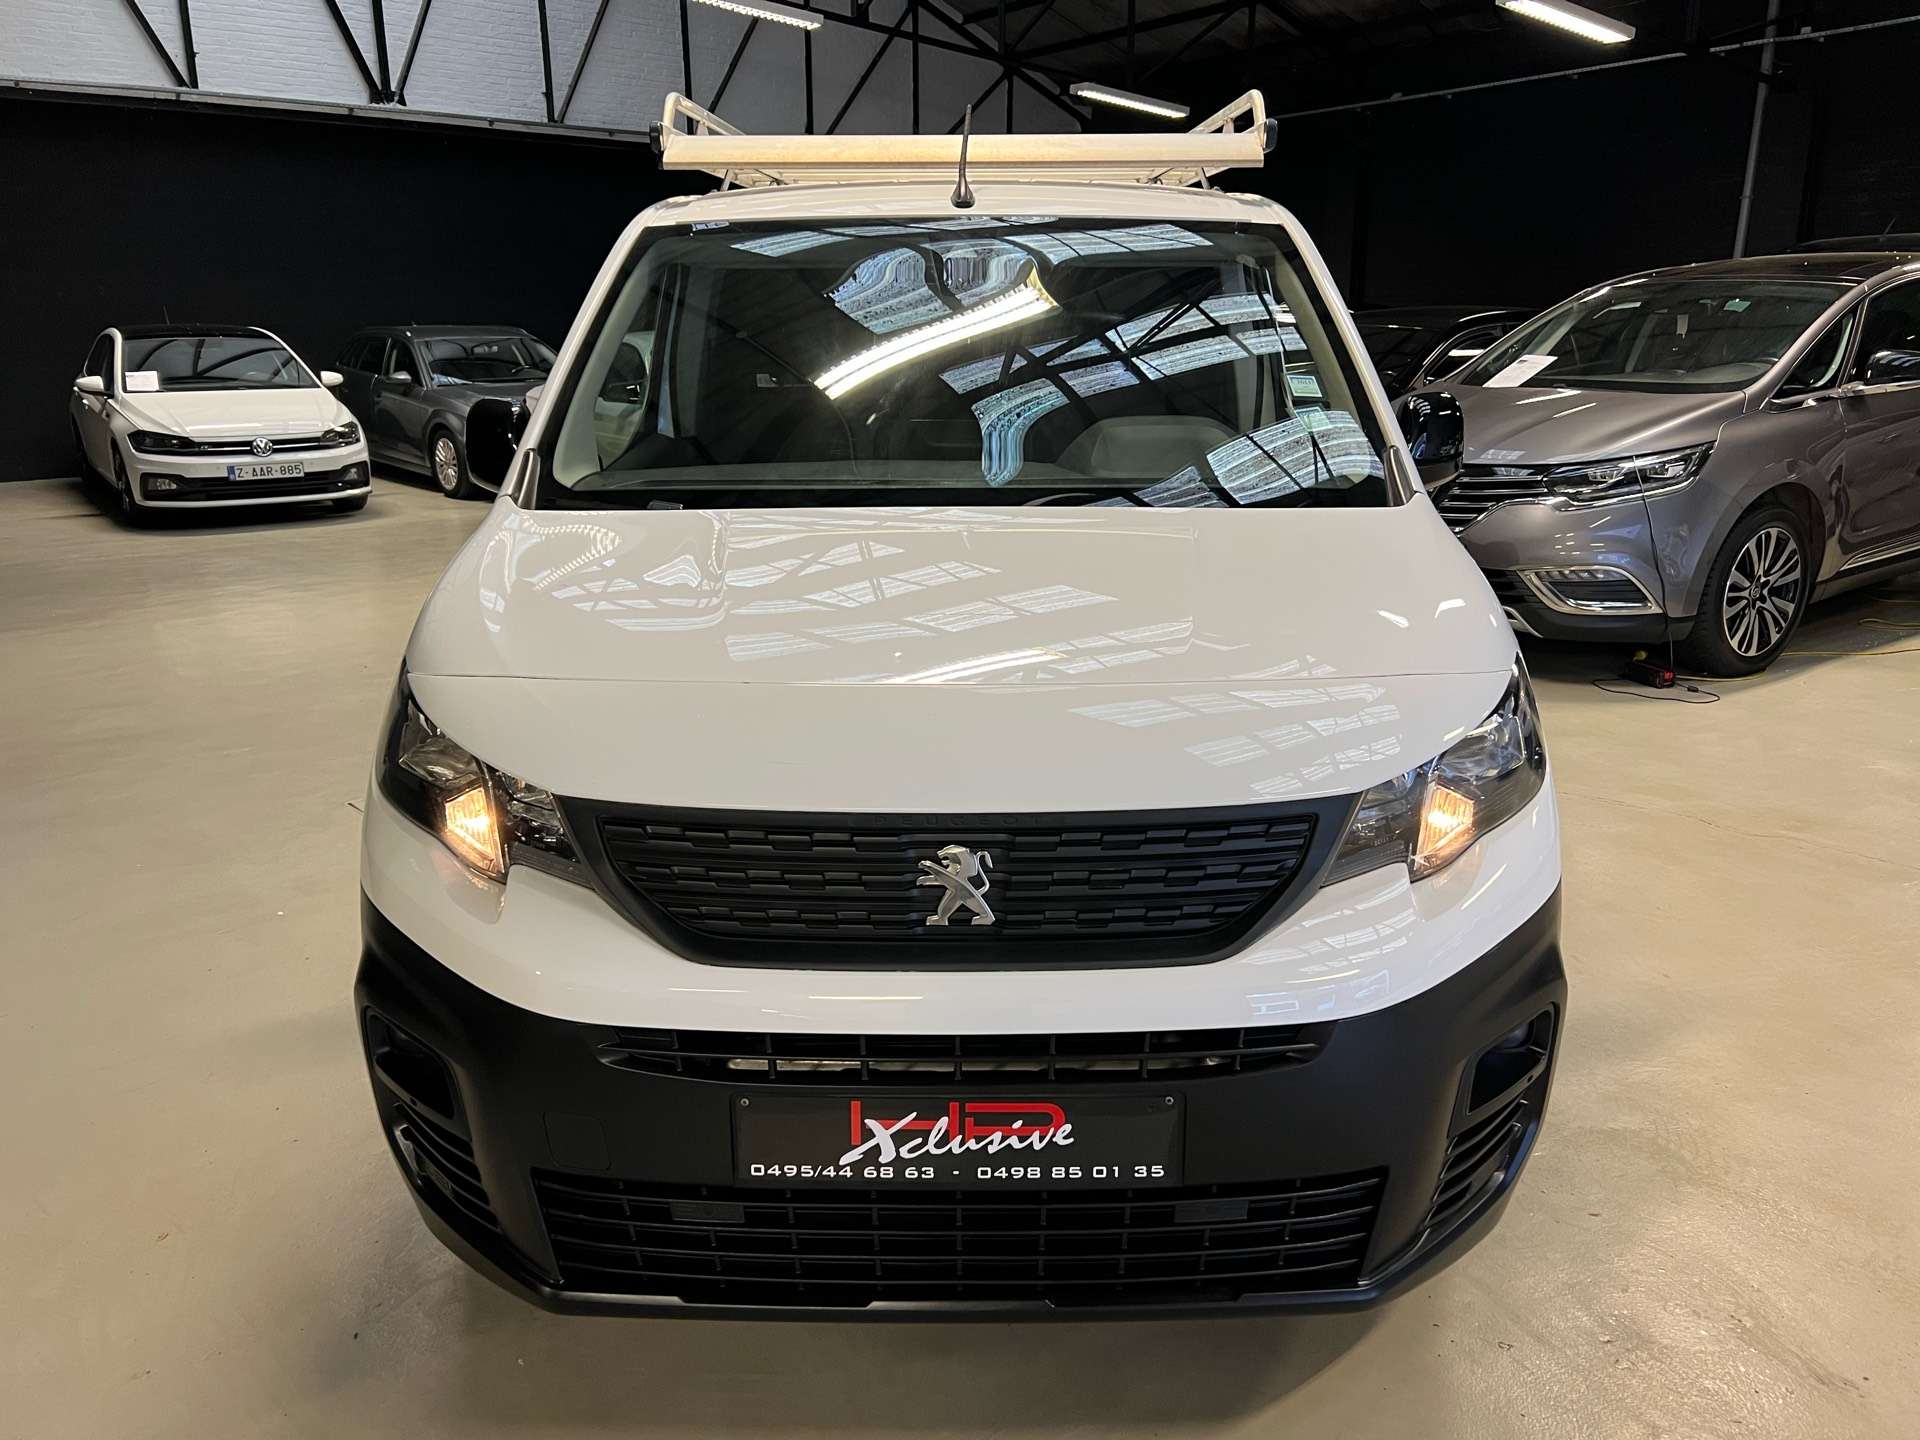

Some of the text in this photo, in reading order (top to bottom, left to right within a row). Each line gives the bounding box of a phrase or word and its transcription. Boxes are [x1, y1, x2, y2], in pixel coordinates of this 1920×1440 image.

[236, 464, 302, 479] Z-AAR-885
[839, 1112, 1075, 1166] Xclusive
[750, 1163, 853, 1178] 0495/44
[863, 1165, 894, 1179] 68
[904, 1166, 935, 1179] 63
[977, 1166, 1041, 1179] 0498
[1051, 1166, 1083, 1179] 85
[1092, 1165, 1119, 1179] 01
[1133, 1165, 1165, 1178] 35
